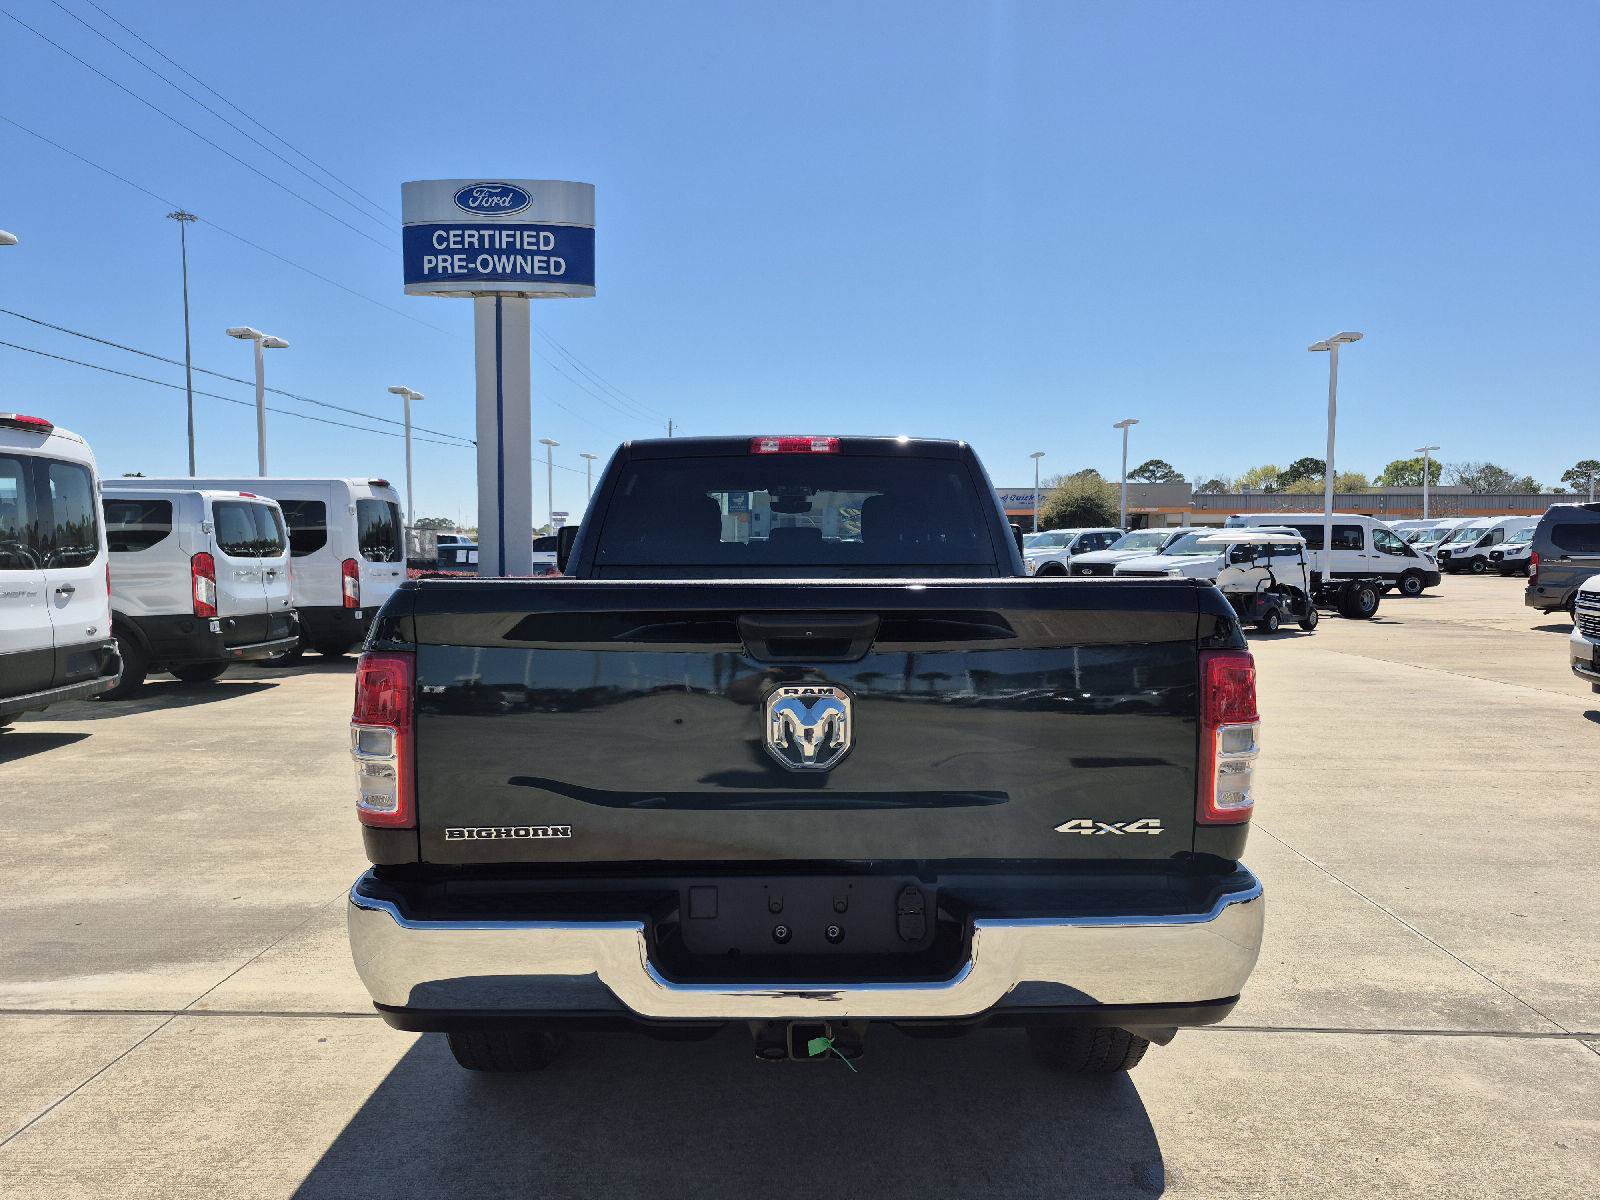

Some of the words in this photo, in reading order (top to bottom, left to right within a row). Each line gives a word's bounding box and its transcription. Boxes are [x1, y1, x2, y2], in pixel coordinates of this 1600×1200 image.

[469, 186, 514, 208] Ford
[432, 229, 556, 251] CERTIFIED
[423, 253, 567, 276] PRE-OWNED
[445, 826, 572, 841] BIGHORN
